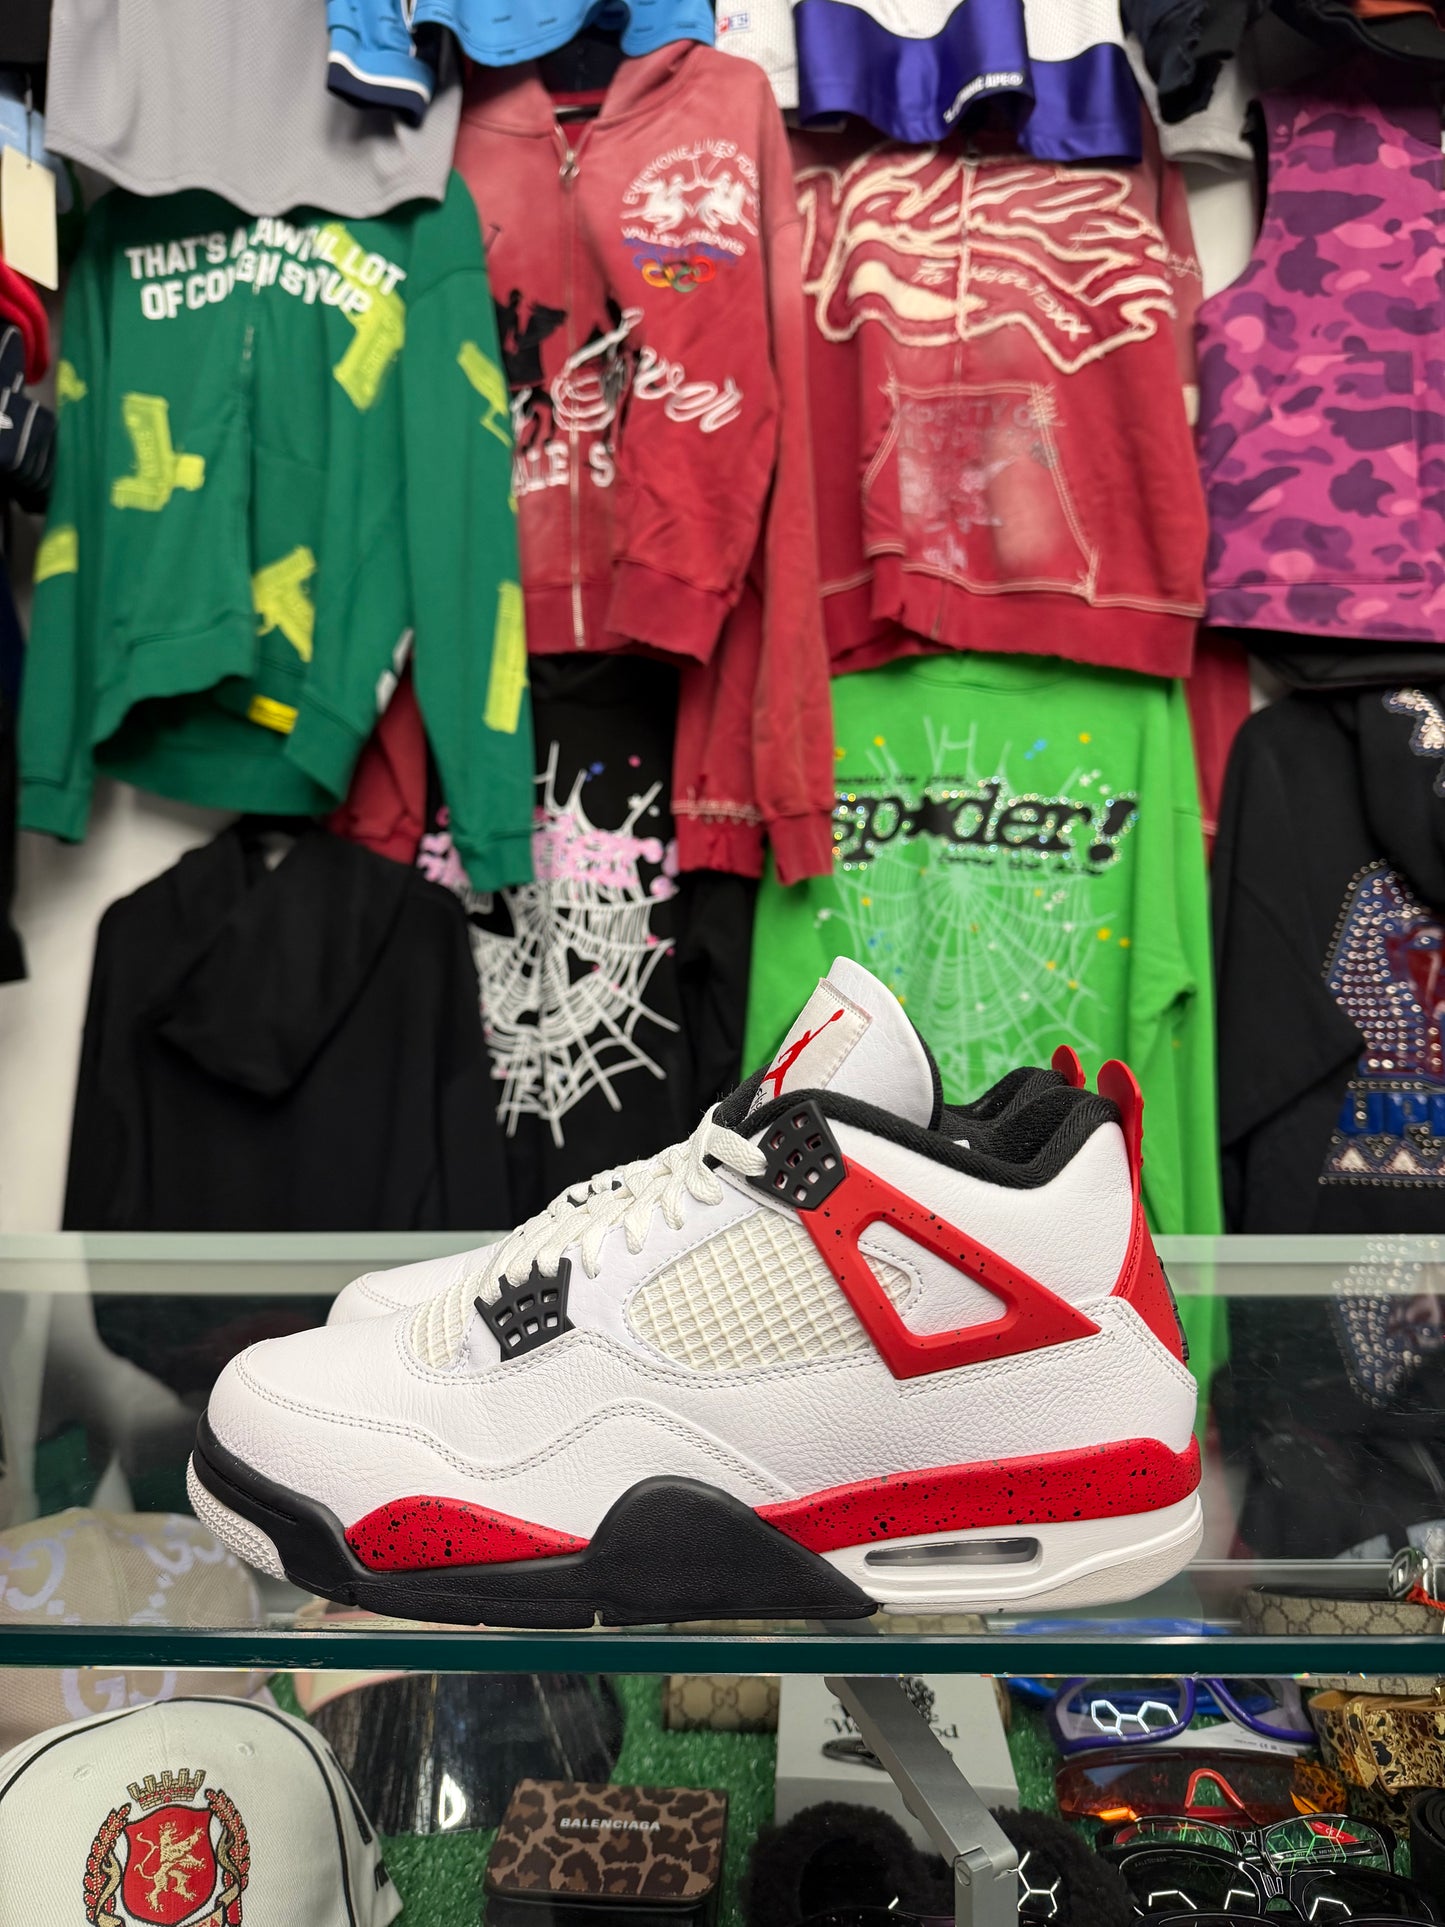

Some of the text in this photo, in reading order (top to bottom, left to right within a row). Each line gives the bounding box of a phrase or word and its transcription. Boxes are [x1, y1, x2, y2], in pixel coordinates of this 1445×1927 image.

[125, 232, 227, 279] THAT'S
[340, 246, 407, 296] LOT
[141, 280, 183, 320] OF
[560, 1818, 660, 1831] BALENCIAGA
